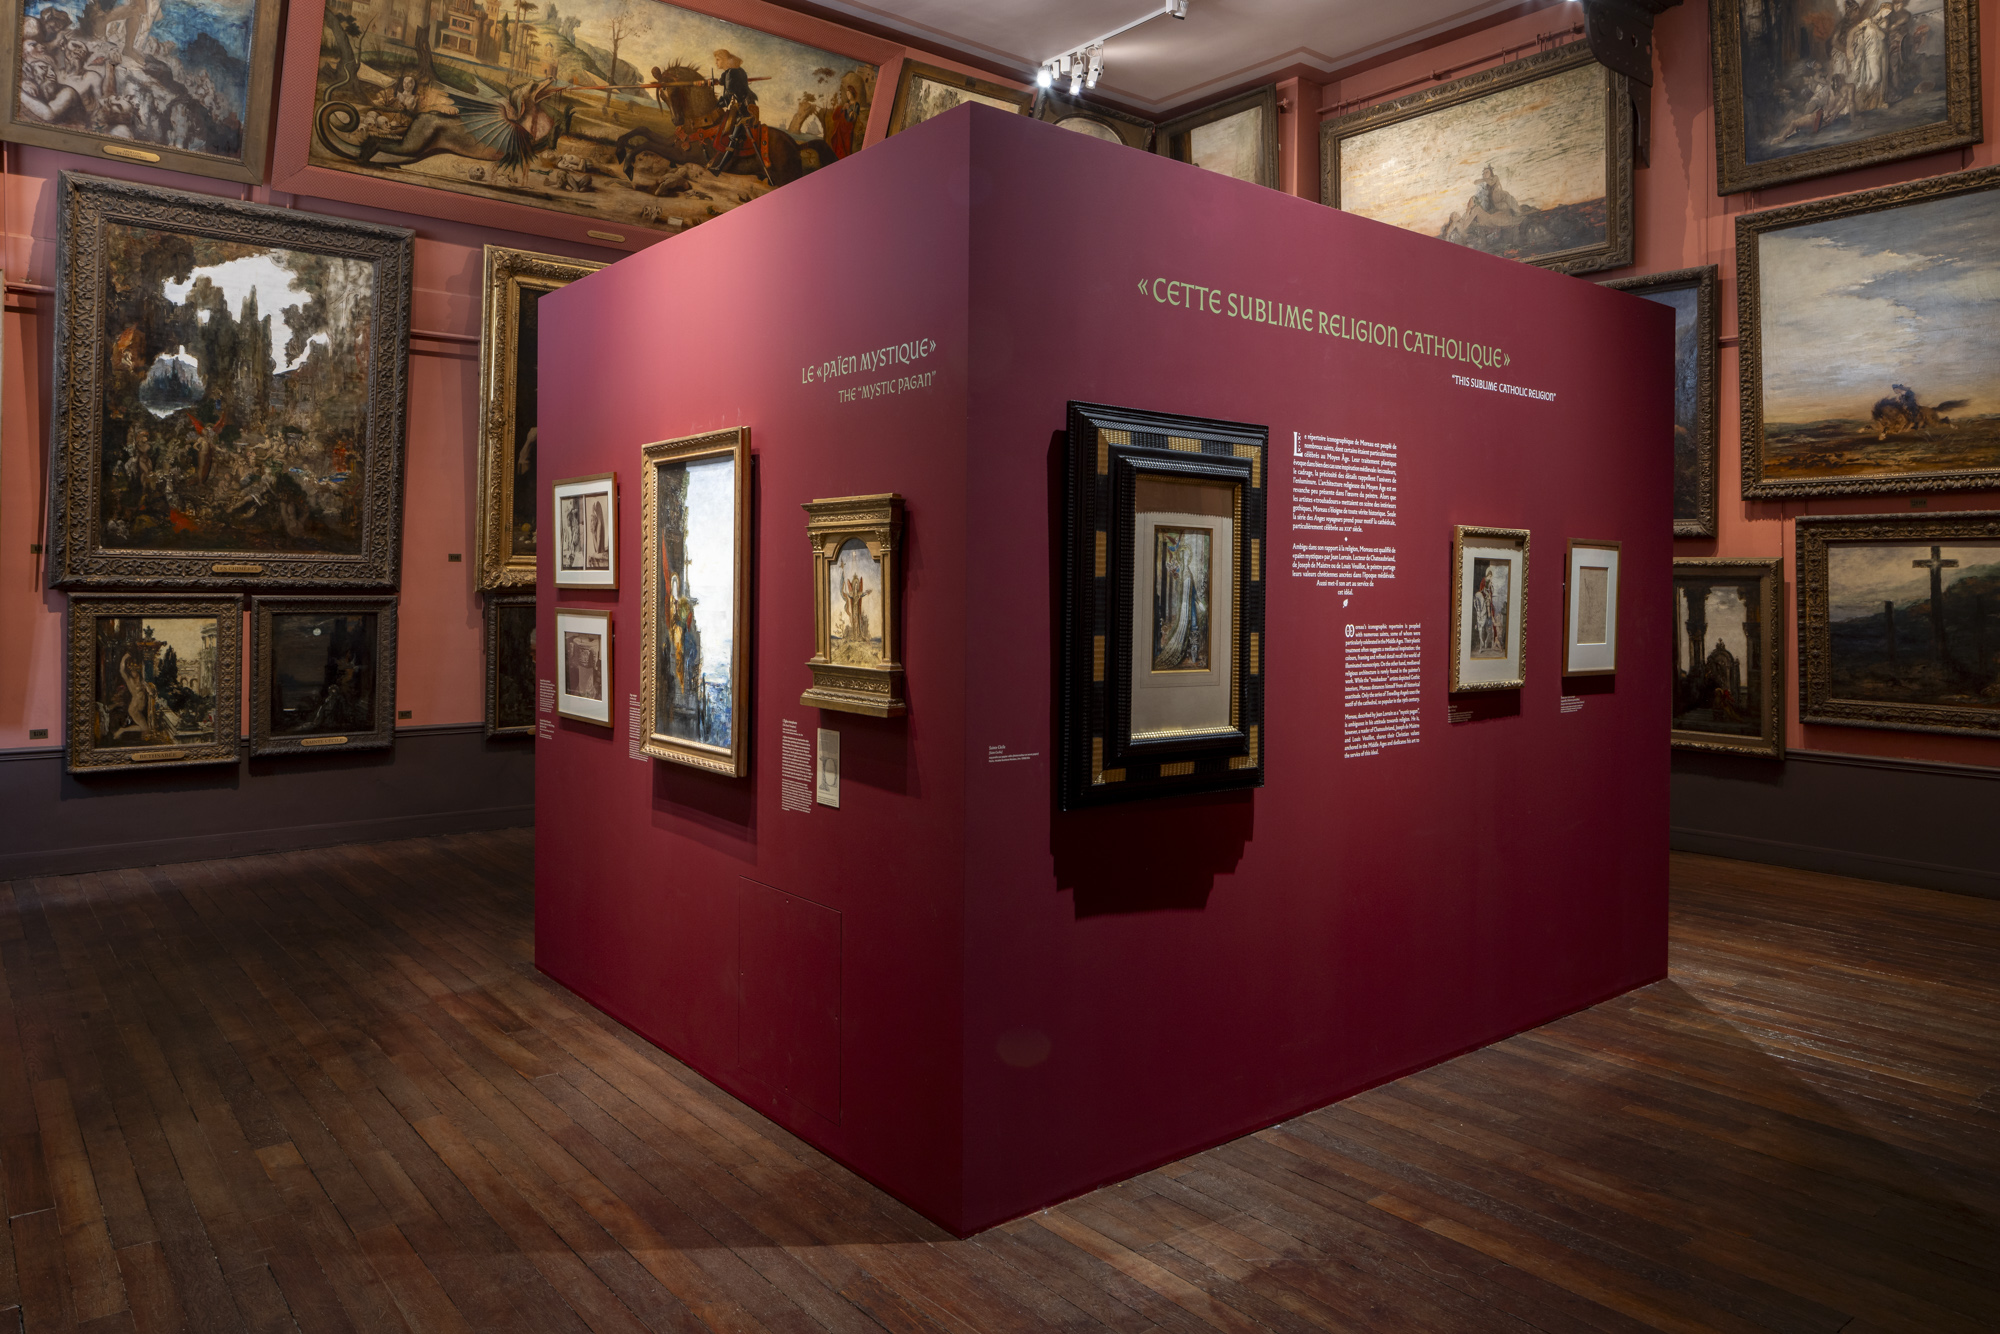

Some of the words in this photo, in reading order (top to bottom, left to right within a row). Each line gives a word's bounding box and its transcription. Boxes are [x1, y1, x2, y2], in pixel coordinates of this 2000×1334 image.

[1227, 292, 1314, 332] SUBLIME
[1318, 310, 1399, 349] RELIGION
[801, 365, 815, 385] LE
[838, 387, 857, 403] THE
[1470, 377, 1498, 392] SUBLIME
[1498, 382, 1528, 397] CATHOLIC
